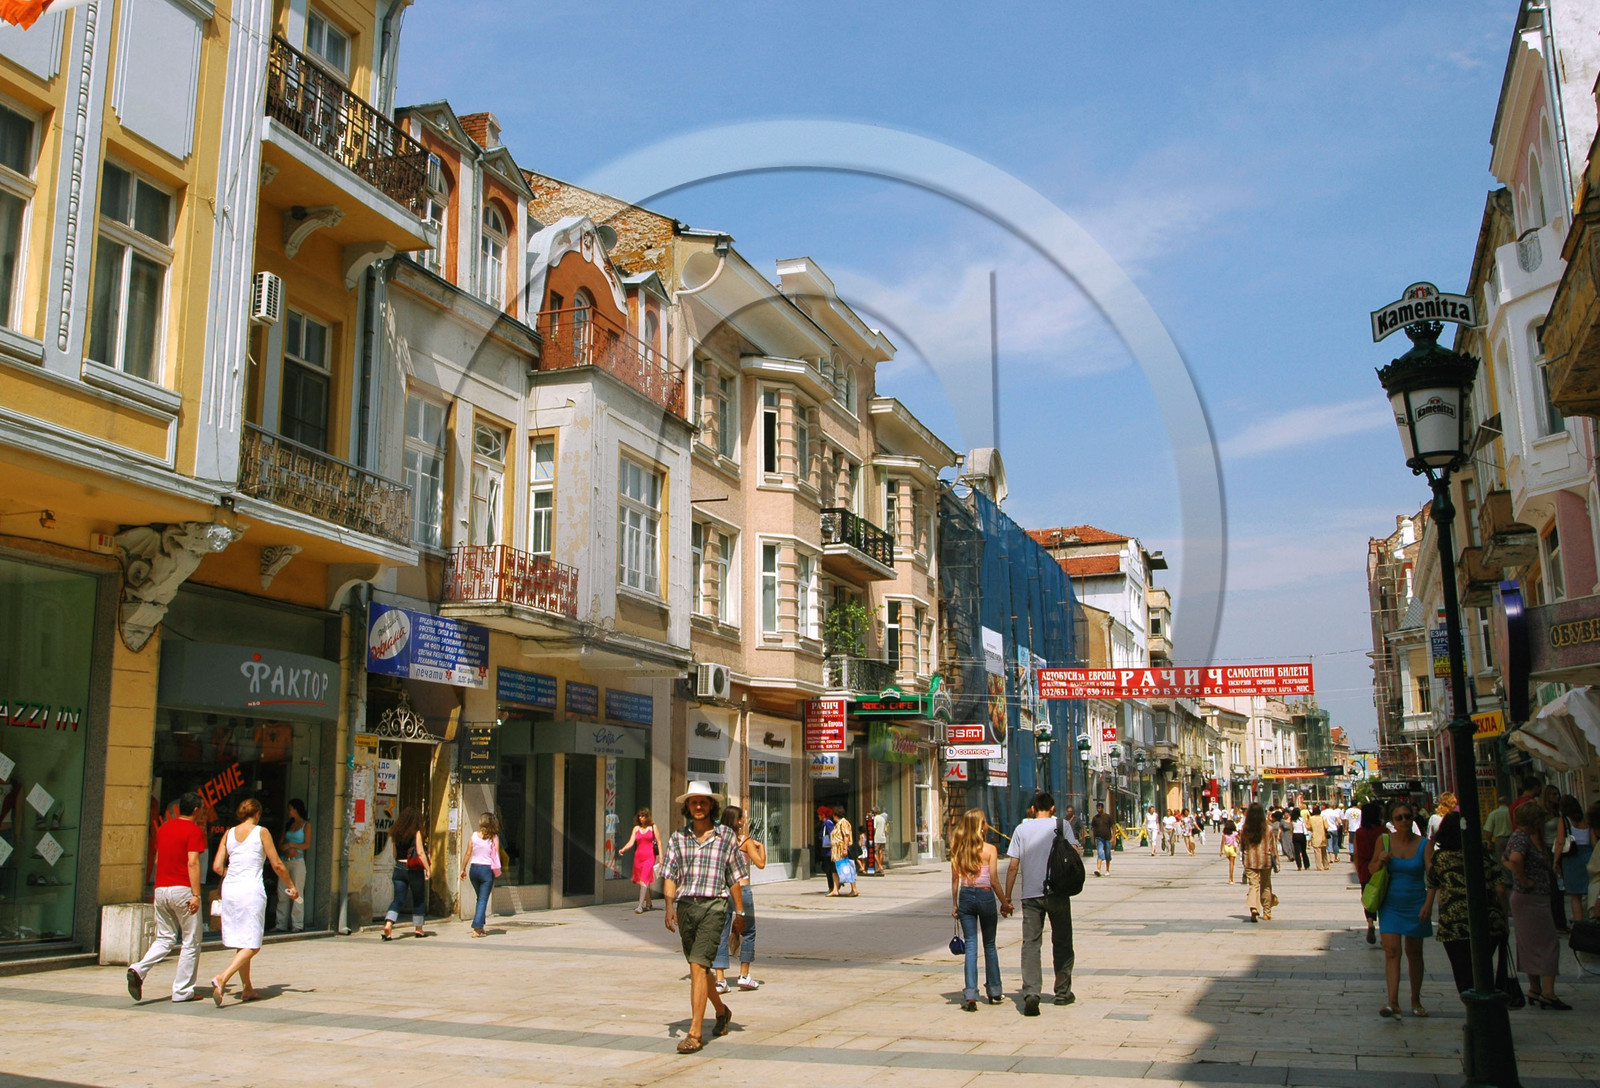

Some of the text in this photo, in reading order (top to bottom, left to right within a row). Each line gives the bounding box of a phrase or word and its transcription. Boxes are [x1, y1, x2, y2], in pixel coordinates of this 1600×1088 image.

[1377, 295, 1470, 335] Kamenitza
[1416, 403, 1454, 419] Kamenitza
[416, 668, 444, 680] печати
[1042, 672, 1078, 680] АВТОБУСИ
[1088, 671, 1116, 680] ЕВРОПА
[1120, 668, 1223, 687] РАЧИЧ
[1227, 666, 1309, 678] САМОЛЕТНИ БИЛЕТИ
[1042, 688, 1068, 696] 032/631
[1102, 688, 1114, 696] 717
[1122, 686, 1222, 696] ЕВРОБУС BG
[811, 702, 839, 710] РАЧИЧ
[889, 702, 914, 710] CAFE
[56, 705, 82, 732] IN
[813, 755, 834, 764] ART
